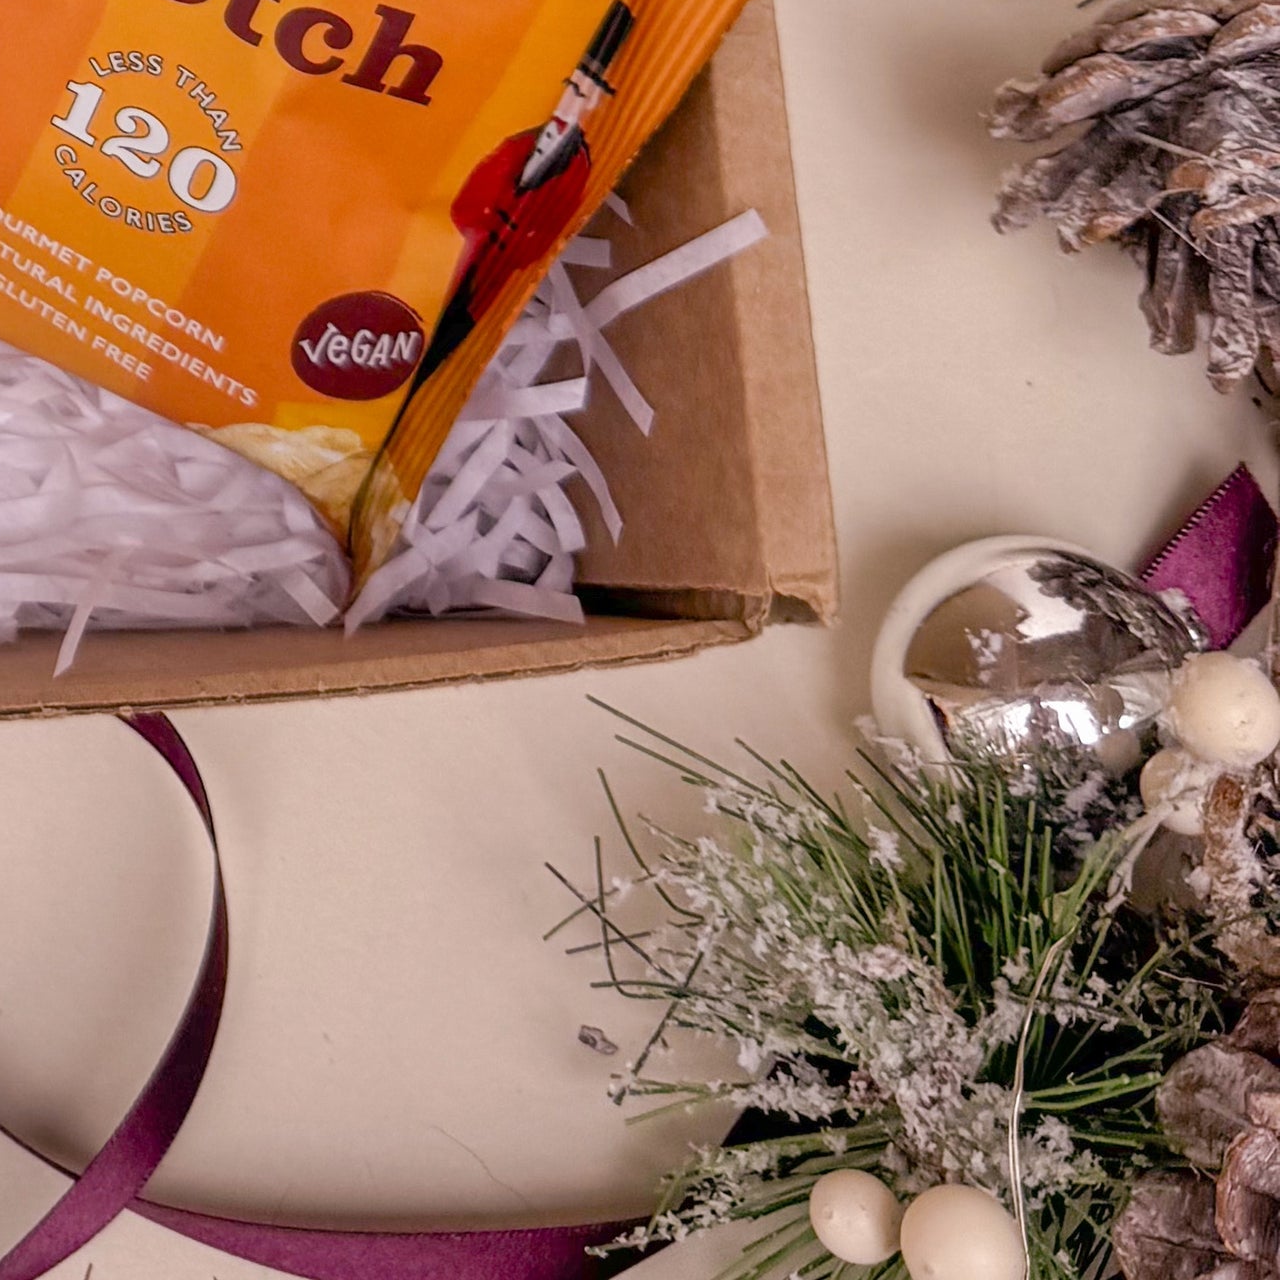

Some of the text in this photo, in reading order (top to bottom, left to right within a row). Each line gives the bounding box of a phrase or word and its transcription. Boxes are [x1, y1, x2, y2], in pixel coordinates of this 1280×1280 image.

[50, 80, 238, 214] 120
[89, 50, 243, 153] LESS THAN
[54, 144, 194, 234] CALORIES
[83, 295, 258, 407] INGREDIENTS
[91, 334, 154, 382] FREE
[95, 267, 226, 353] POPCORN
